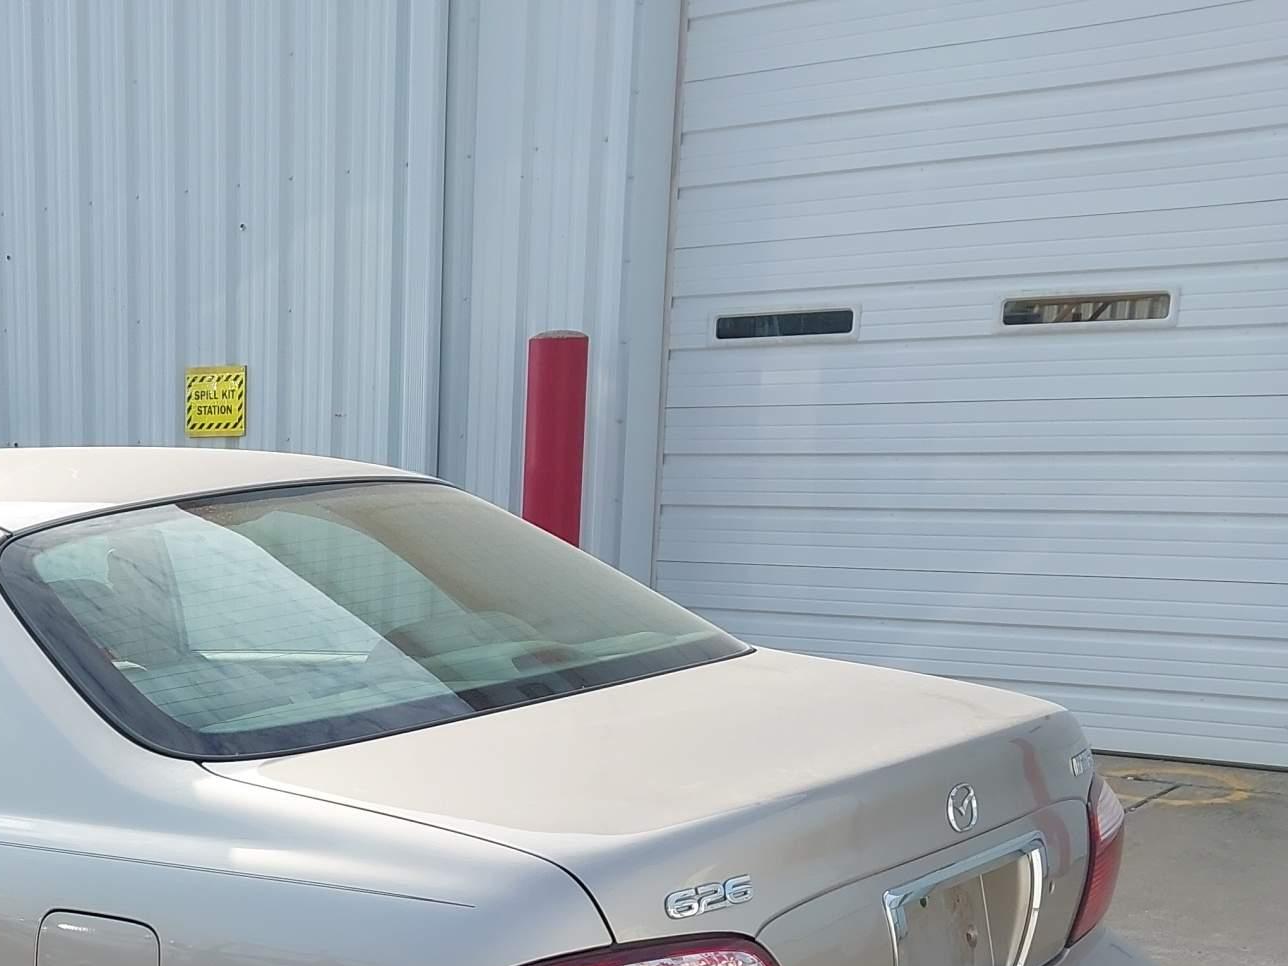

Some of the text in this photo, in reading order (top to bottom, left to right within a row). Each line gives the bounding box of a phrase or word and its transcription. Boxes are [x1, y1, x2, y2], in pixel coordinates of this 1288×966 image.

[194, 389, 235, 400] SPILL KIT
[197, 405, 232, 415] STATION
[664, 874, 753, 920] 626
